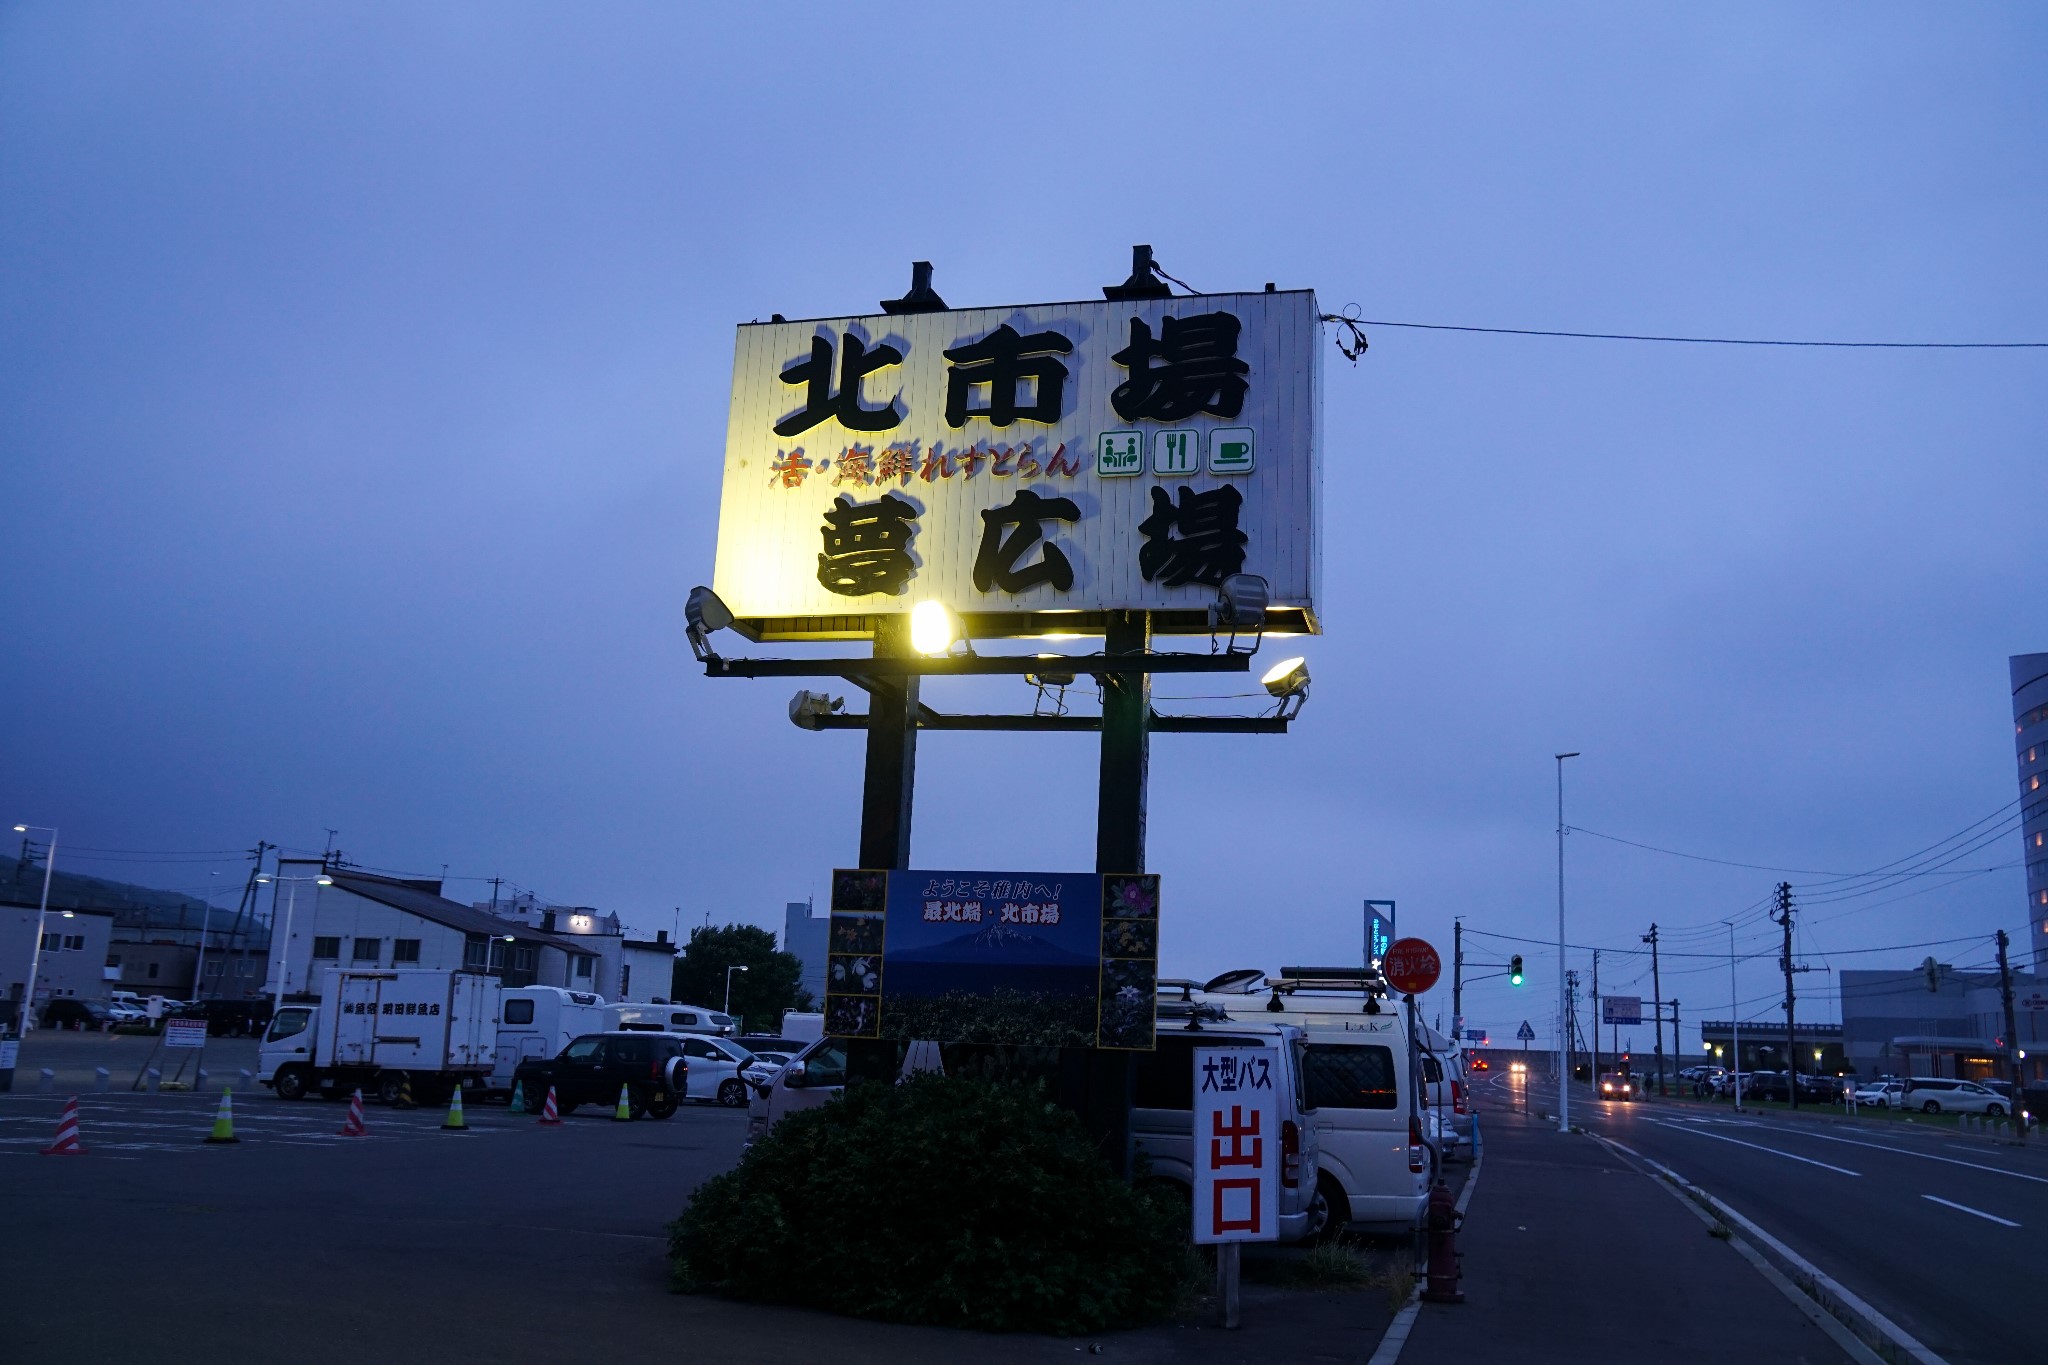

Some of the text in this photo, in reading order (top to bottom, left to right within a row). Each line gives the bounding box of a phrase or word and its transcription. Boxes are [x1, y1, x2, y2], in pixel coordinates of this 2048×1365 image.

[772, 311, 1249, 437] 北市場
[817, 484, 1249, 596] 夢広場
[1389, 954, 1436, 976] 消火栓
[1201, 1055, 1272, 1093] 大型バス
[1210, 1105, 1263, 1235] 出口
